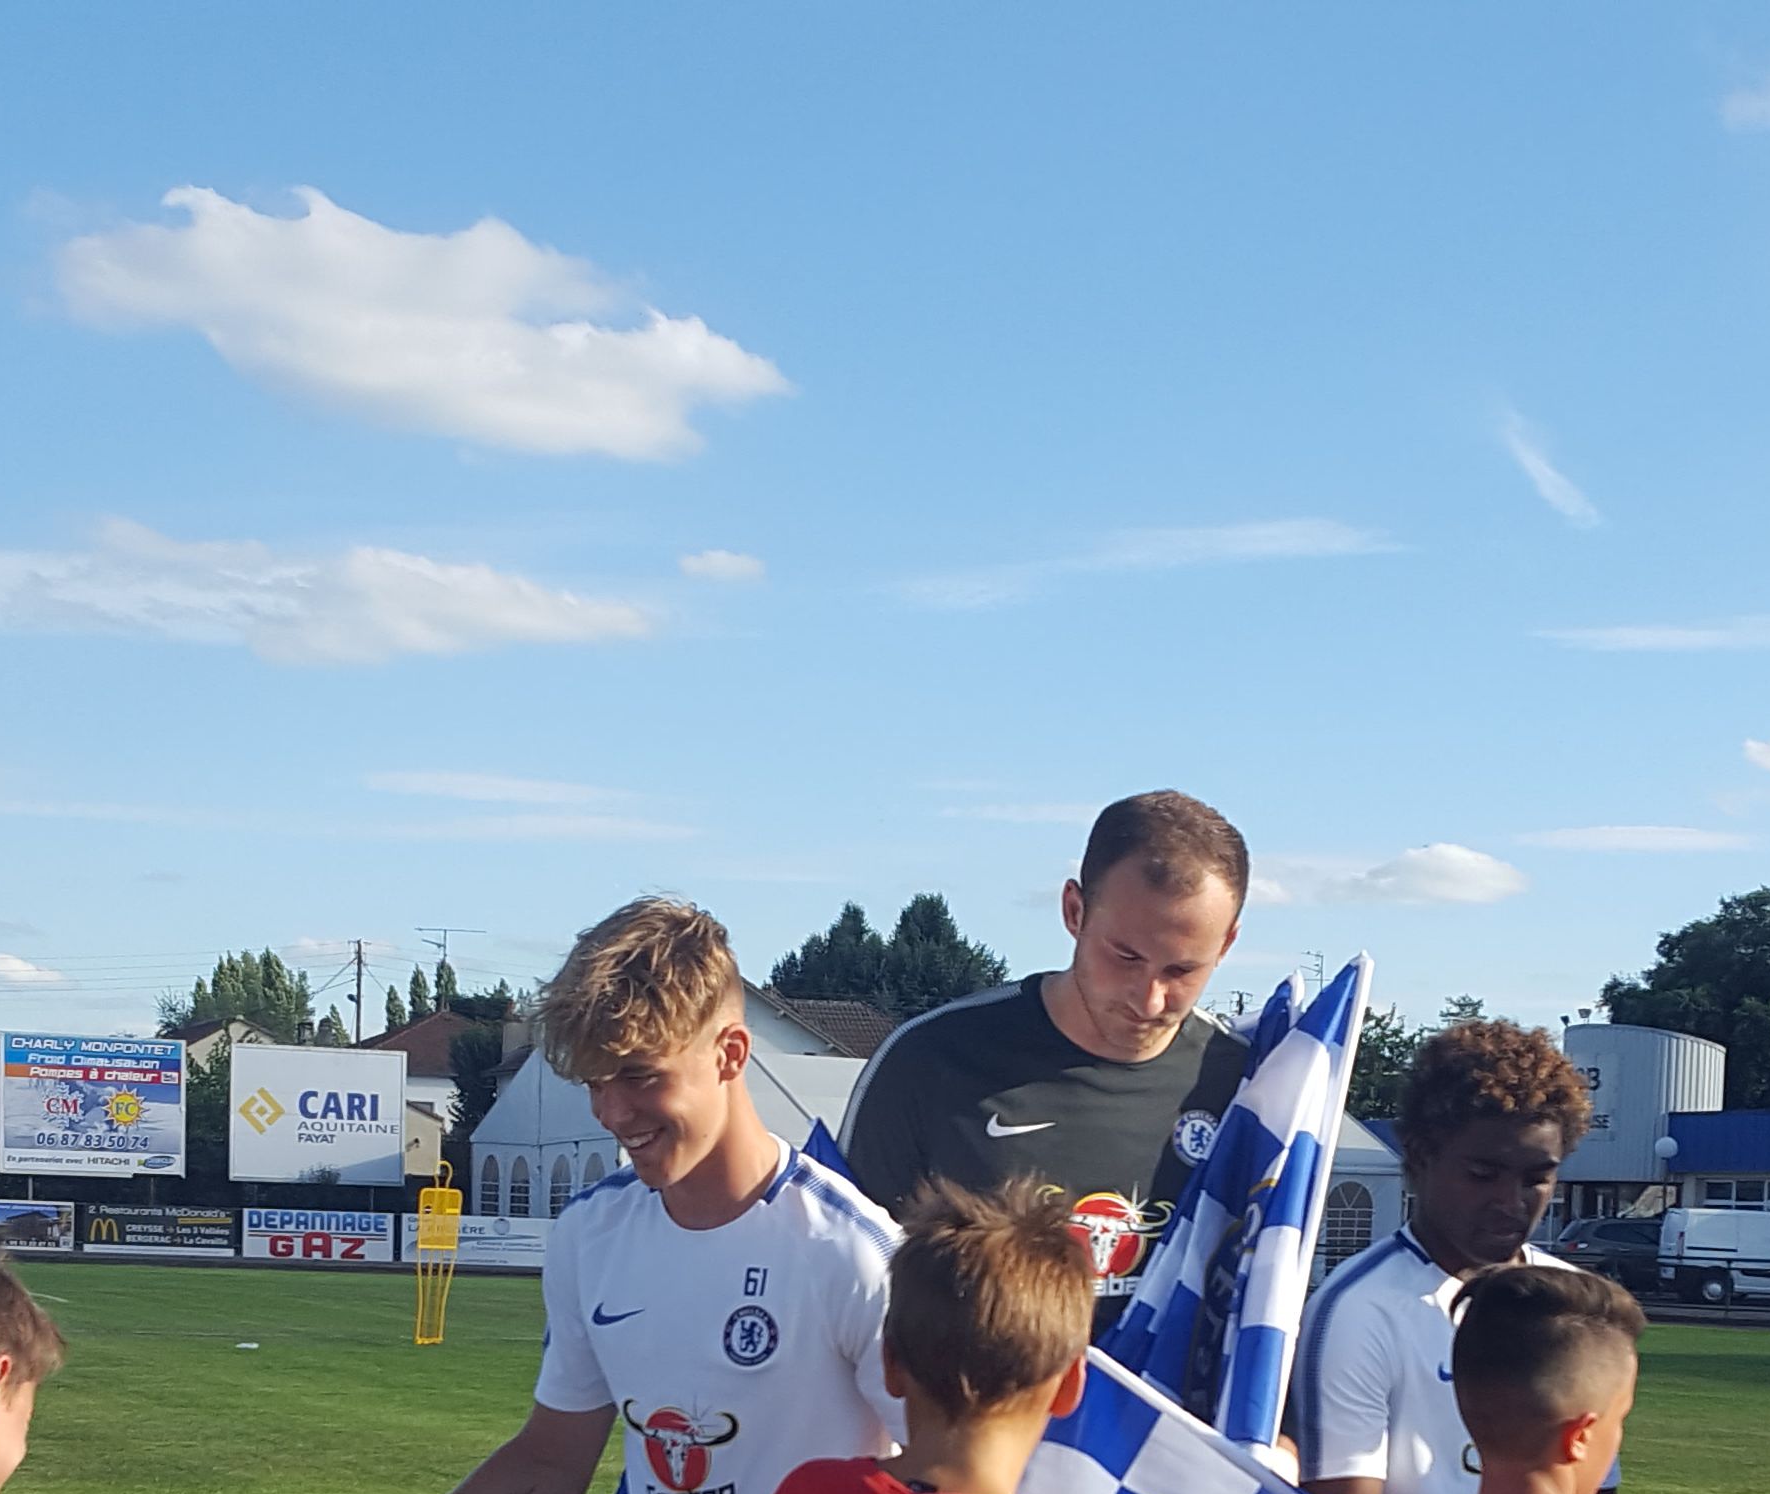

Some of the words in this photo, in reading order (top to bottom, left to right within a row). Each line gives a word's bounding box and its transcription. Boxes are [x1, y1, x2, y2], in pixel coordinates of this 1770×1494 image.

[11, 1037, 76, 1051] CHARLY
[81, 1041, 176, 1056] MONPONTET
[27, 1053, 67, 1065] Froid
[71, 1055, 160, 1069] Climatisation
[29, 1067, 84, 1079] Pompes
[89, 1068, 99, 1080] à
[104, 1070, 158, 1082] chaleur
[45, 1097, 78, 1115] CM
[115, 1102, 137, 1117] FC
[297, 1089, 379, 1122] CARI
[297, 1121, 400, 1135] AQUITAINE
[36, 1132, 56, 1146] 06
[60, 1133, 80, 1147] 87
[84, 1134, 102, 1148] 83
[106, 1135, 126, 1149] 50
[130, 1136, 150, 1150] 74
[297, 1133, 336, 1144] FAYAT
[87, 1157, 131, 1167] HITACHI
[88, 1205, 96, 1214] 2
[99, 1206, 163, 1217] Restaurants
[247, 1209, 389, 1234] DEPANNAGE
[268, 1231, 367, 1261] GAZ
[743, 1267, 769, 1297] 61
